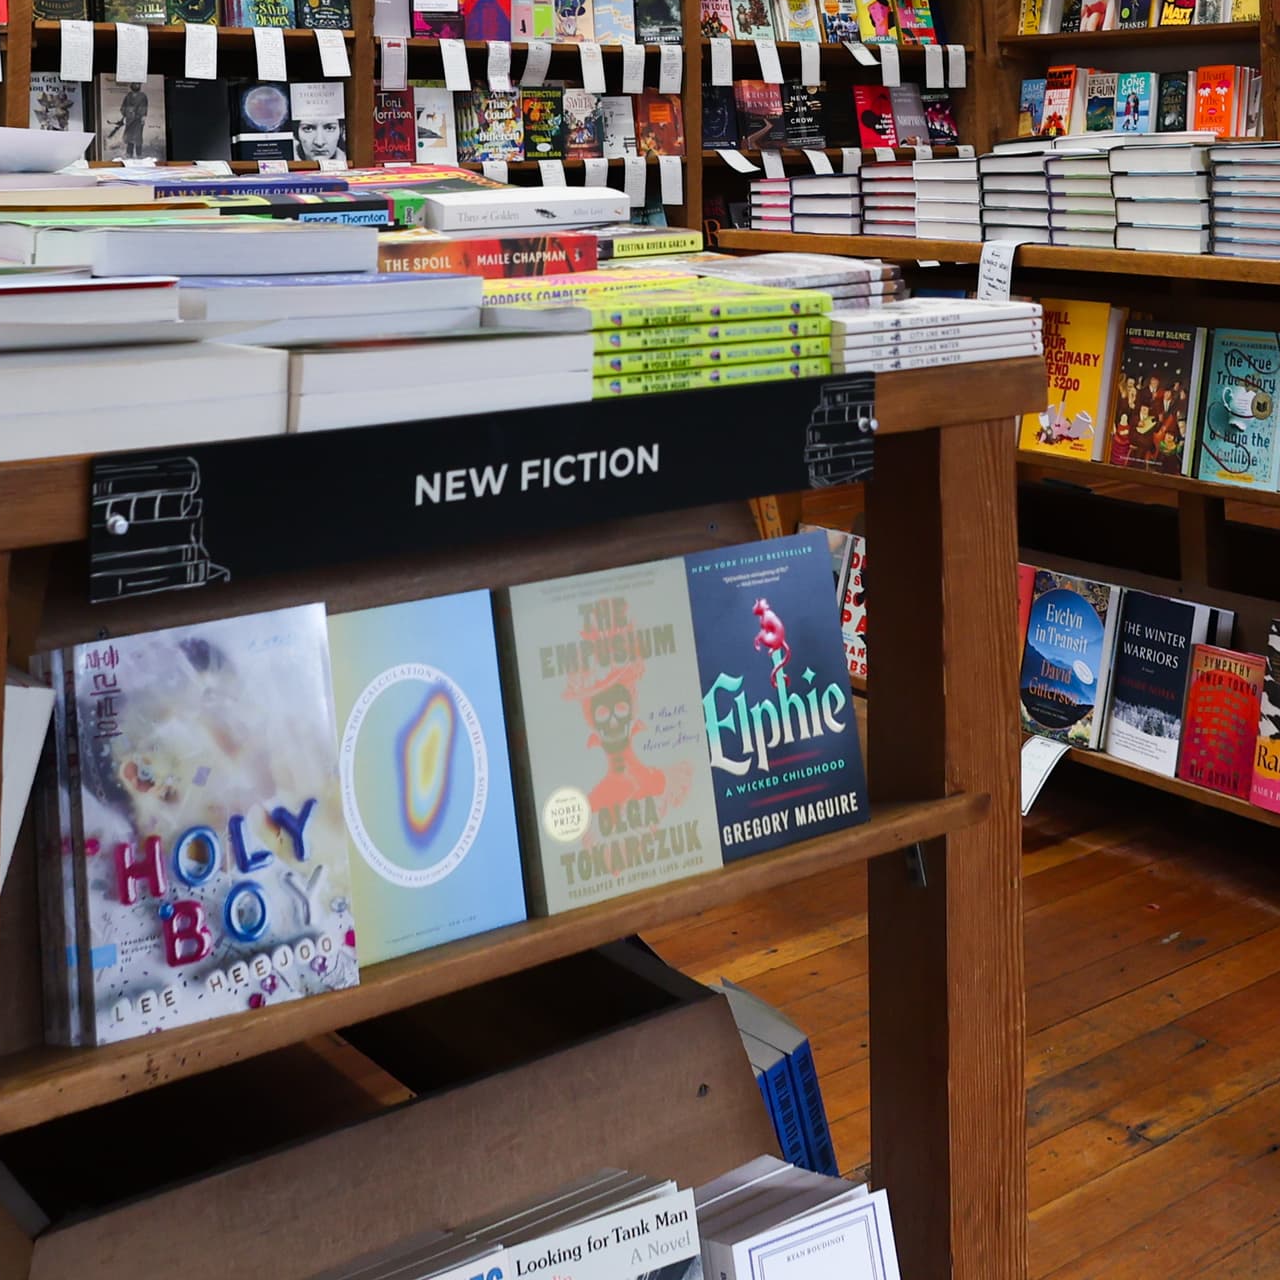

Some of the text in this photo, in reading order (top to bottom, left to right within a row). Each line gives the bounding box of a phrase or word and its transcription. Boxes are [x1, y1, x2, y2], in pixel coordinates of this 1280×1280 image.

[790, 116, 814, 124] CROW
[476, 249, 566, 267] MAILE CHAPMAN
[617, 239, 688, 253] CRISTINA RIVERA GARZA
[384, 256, 451, 273] THE SPOIL
[414, 444, 660, 507] NEW FICTION
[578, 597, 629, 628] THE
[1046, 603, 1083, 632] Evelyn
[540, 624, 677, 679] EMPUSIUM
[1035, 624, 1089, 655] in Transit
[1124, 620, 1186, 649] THE WINTER
[1040, 658, 1072, 683] David
[1123, 641, 1179, 669] WARRIORS
[1028, 678, 1079, 708] Guterson
[703, 648, 847, 775] Elphie
[725, 759, 845, 797] A WICKED CHILDHOOD
[598, 796, 659, 836] OLGA
[723, 792, 858, 846] GREGORY MAGUIRE
[114, 798, 318, 905] HOLY
[559, 821, 703, 885] TOKARCZUK
[161, 865, 327, 967] BOY
[114, 990, 175, 1022] LEE
[209, 938, 332, 992] HEEJOO
[516, 1207, 689, 1276] Looking for Tank Man
[630, 1231, 691, 1265] A Novel
